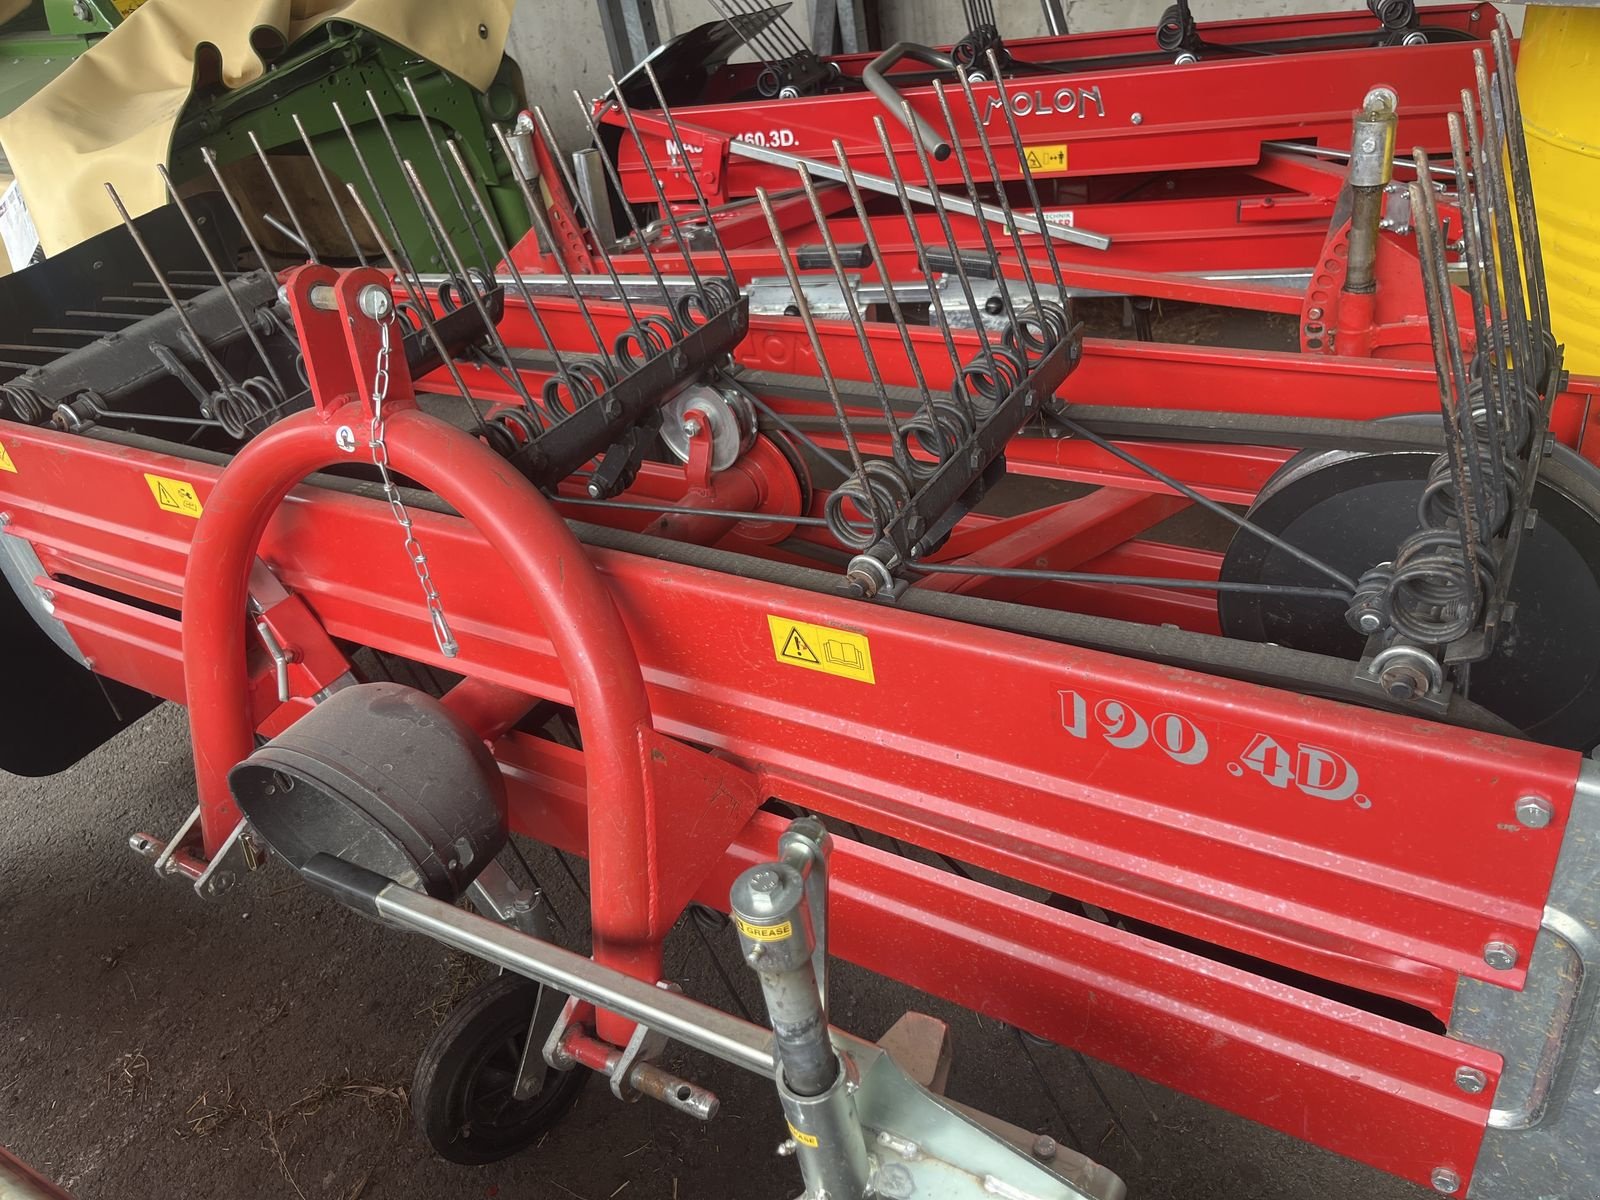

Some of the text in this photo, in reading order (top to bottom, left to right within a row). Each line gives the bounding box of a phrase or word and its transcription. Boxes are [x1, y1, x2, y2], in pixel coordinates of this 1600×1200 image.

[983, 86, 1105, 125] MOLON
[1057, 690, 1208, 765] 190
[746, 924, 790, 937] GREASE
